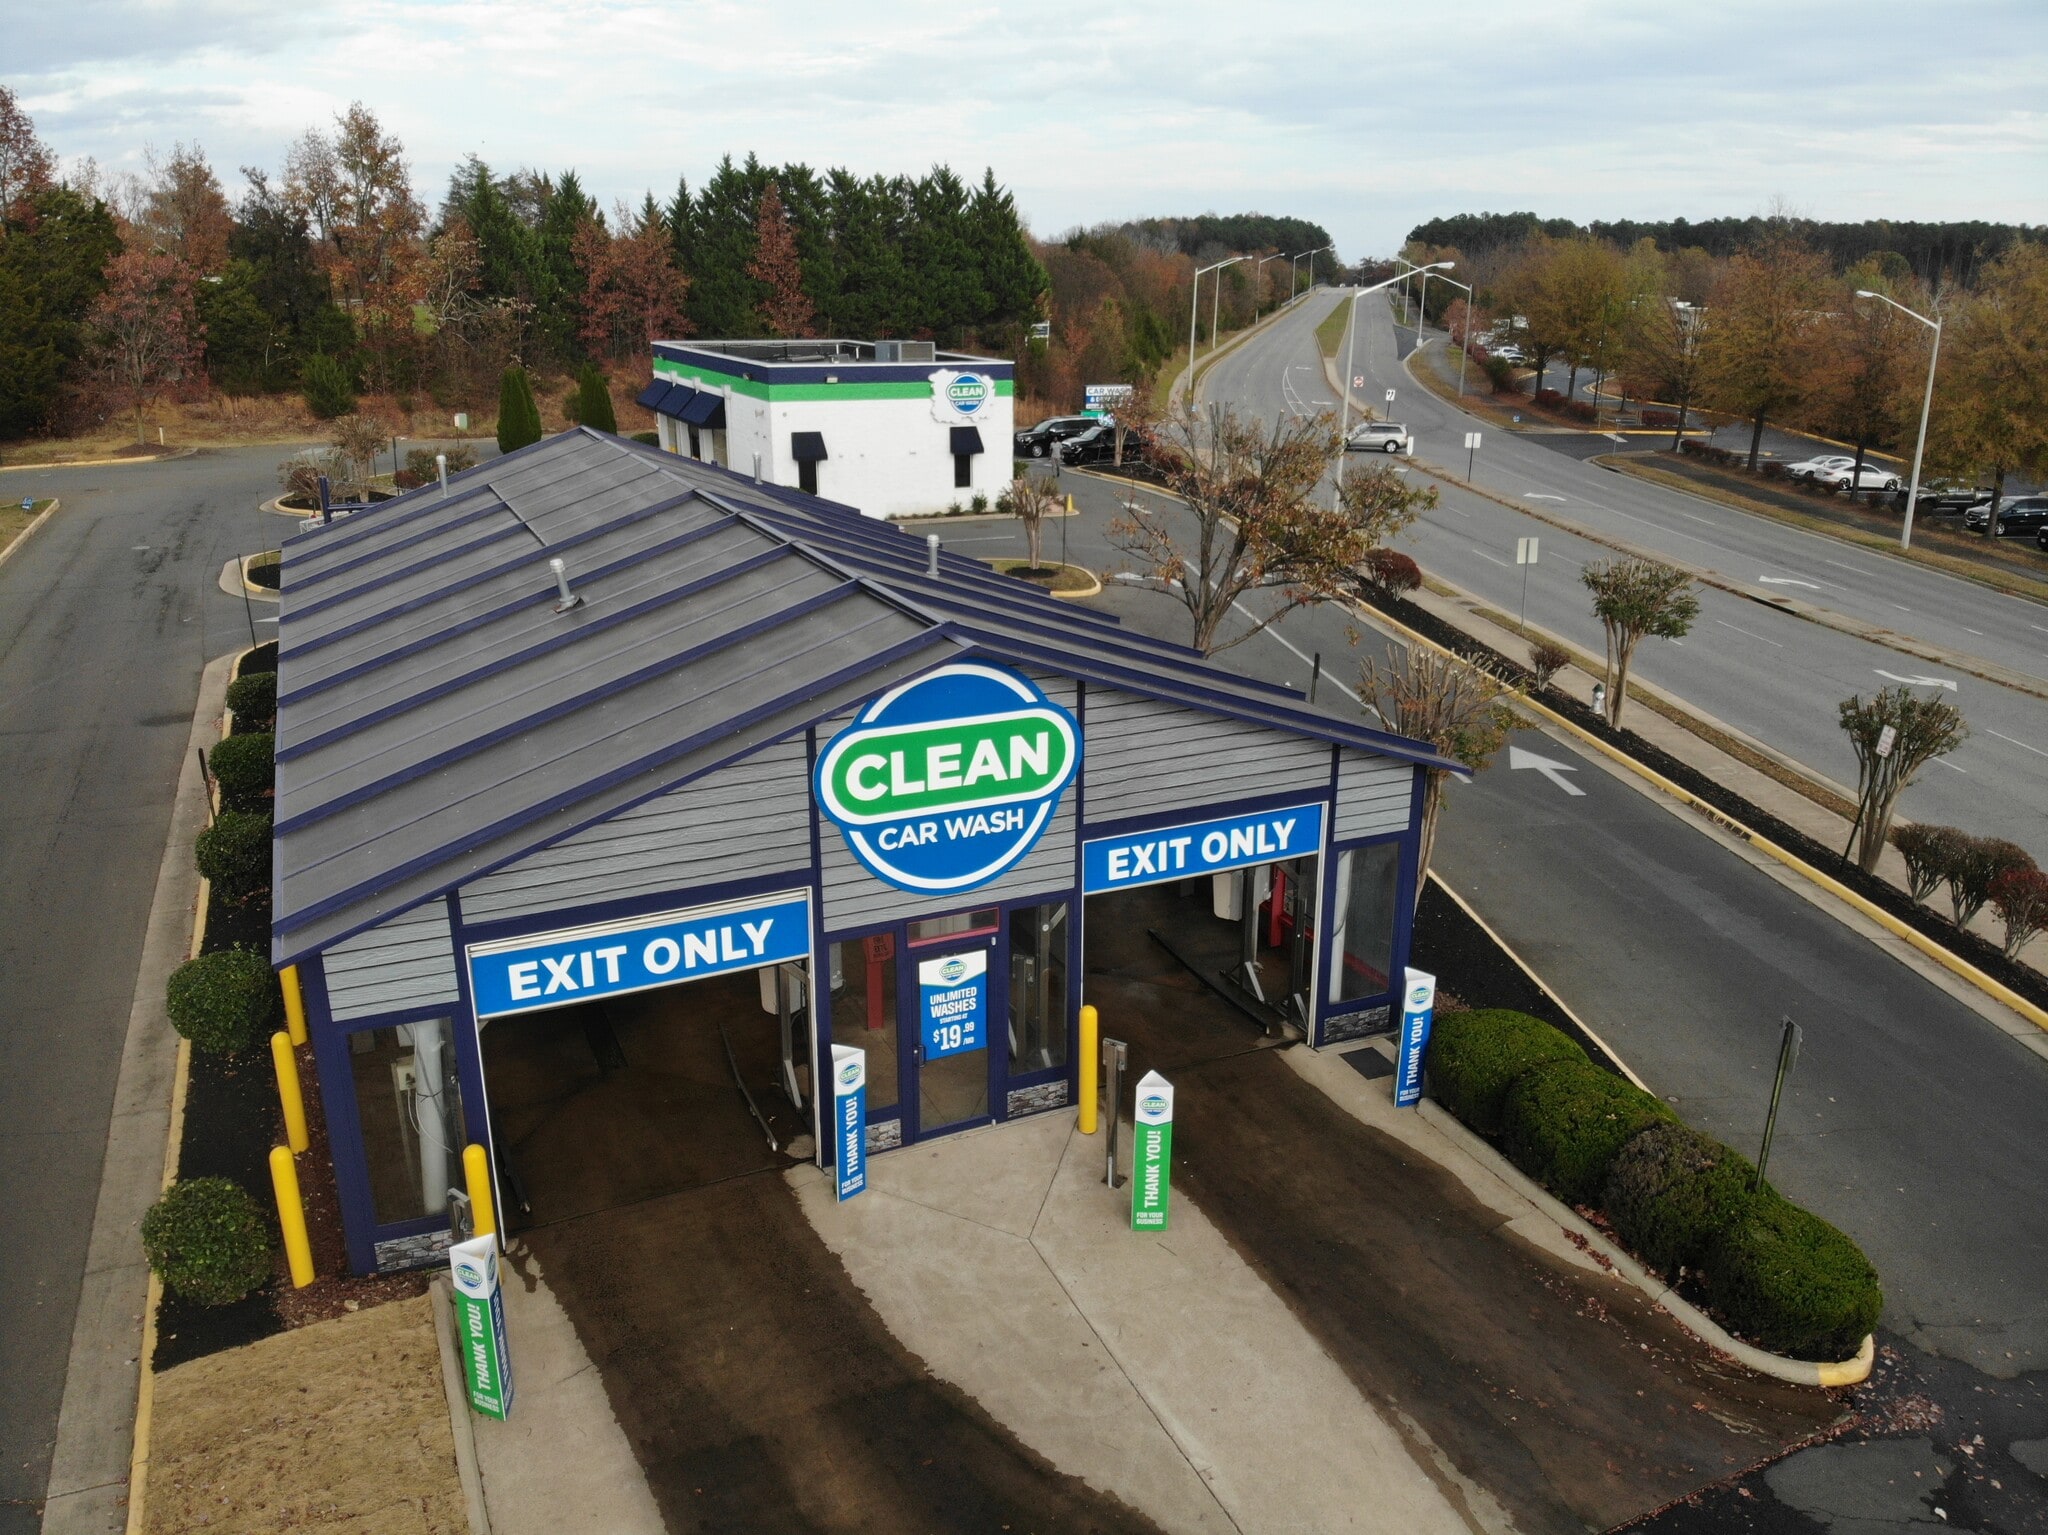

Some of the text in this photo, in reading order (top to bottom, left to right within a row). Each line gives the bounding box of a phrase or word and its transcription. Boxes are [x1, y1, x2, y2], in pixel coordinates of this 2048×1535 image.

[951, 387, 983, 397] CLEAN
[846, 731, 1049, 801] CLEAN
[878, 808, 1024, 850] CAR WASH
[1108, 818, 1296, 881] EXIT ONLY
[508, 918, 774, 1000] EXIT ONLY
[942, 965, 964, 974] CLEAN
[930, 987, 977, 1005] UNLIMITED
[930, 998, 976, 1018] WASHES
[1410, 1016, 1424, 1046] YOU!
[840, 1067, 860, 1079] CLEAN
[1406, 1046, 1420, 1086] THANK
[846, 1096, 858, 1128] YOU!
[847, 1129, 858, 1176] THANK
[1146, 1130, 1162, 1162] YOU!
[842, 1174, 863, 1188] FOR YOUR
[842, 1181, 864, 1195] BUSINESS
[1144, 1164, 1160, 1208] THANK
[458, 1268, 480, 1282] CLEAN
[467, 1302, 484, 1338] YOU!
[472, 1340, 491, 1390] THANK
